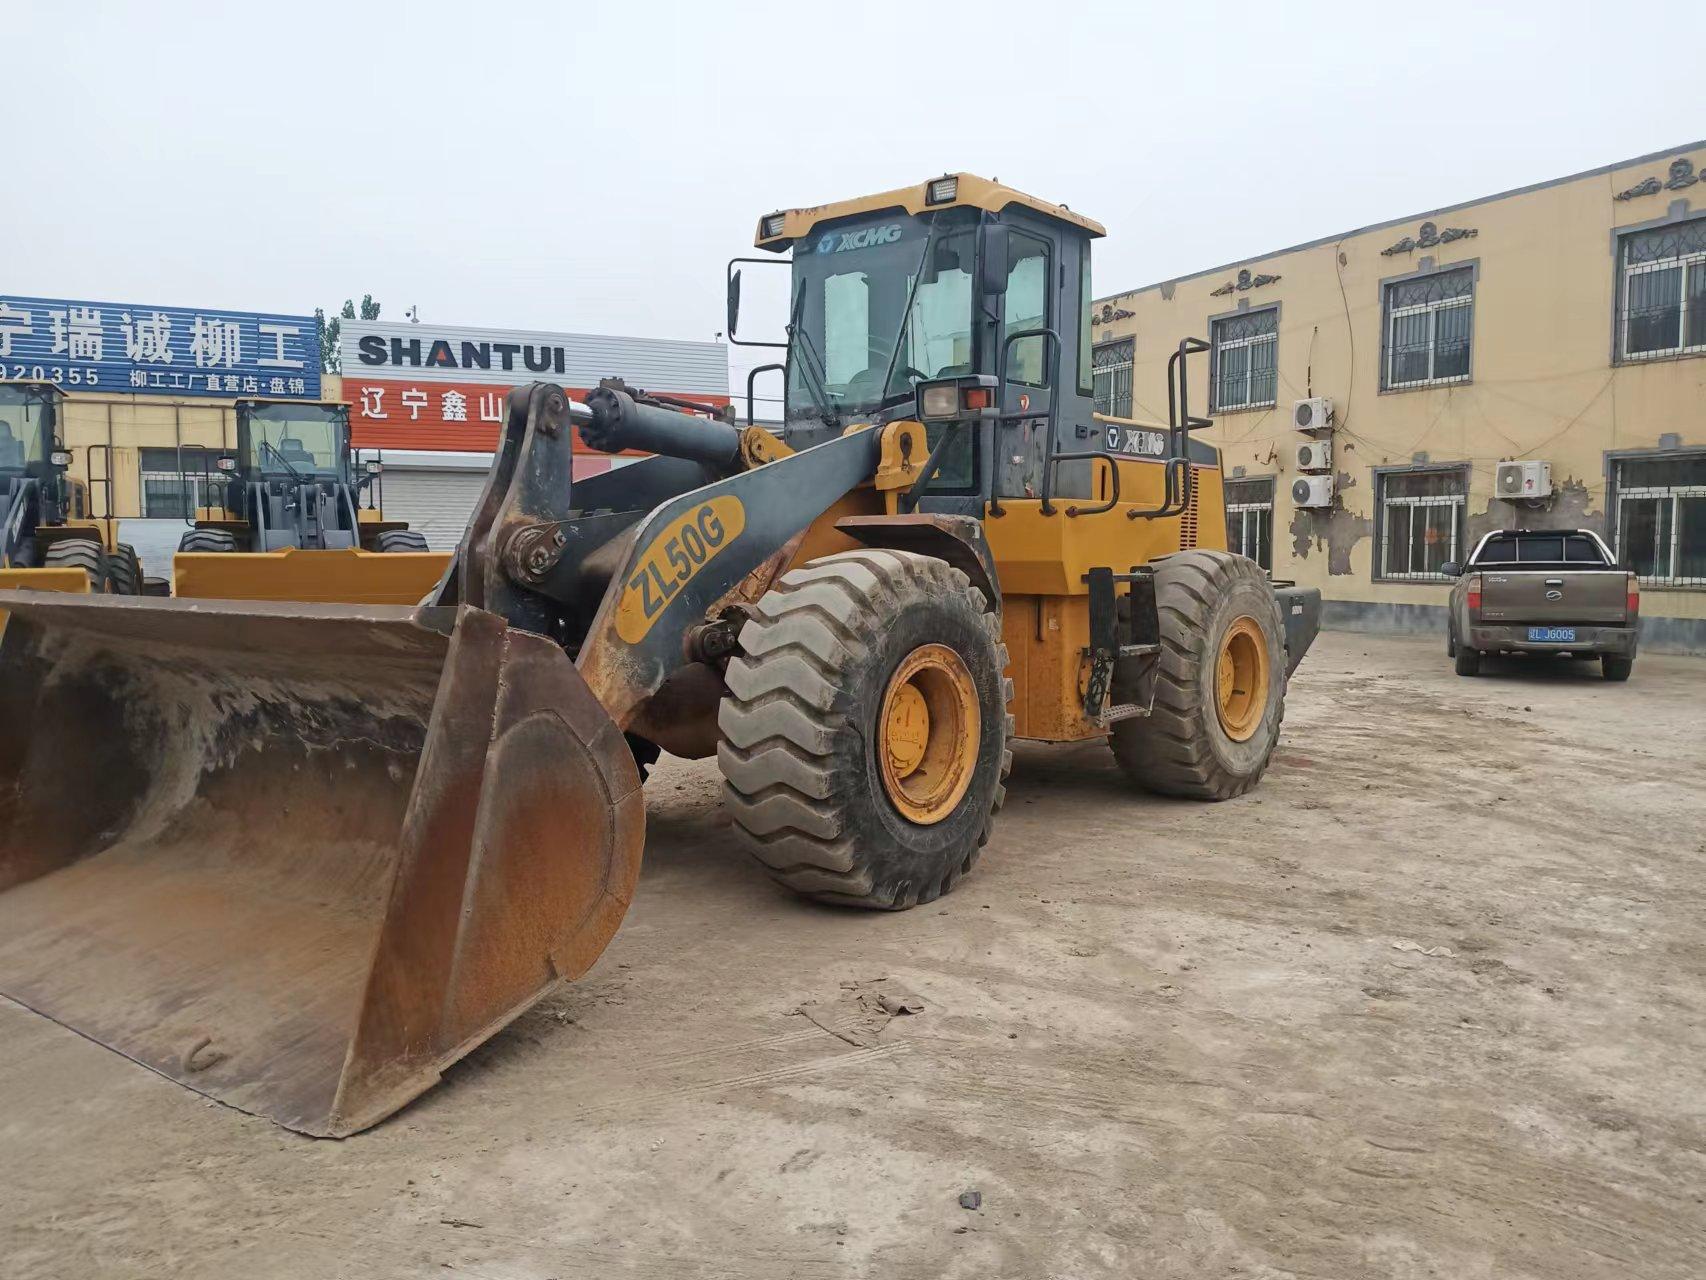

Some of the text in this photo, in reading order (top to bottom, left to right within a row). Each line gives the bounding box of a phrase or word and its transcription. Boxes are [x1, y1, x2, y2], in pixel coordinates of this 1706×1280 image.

[834, 224, 902, 253] XCMG
[358, 335, 566, 374] SHANTUI
[629, 505, 725, 620] ZL50G
